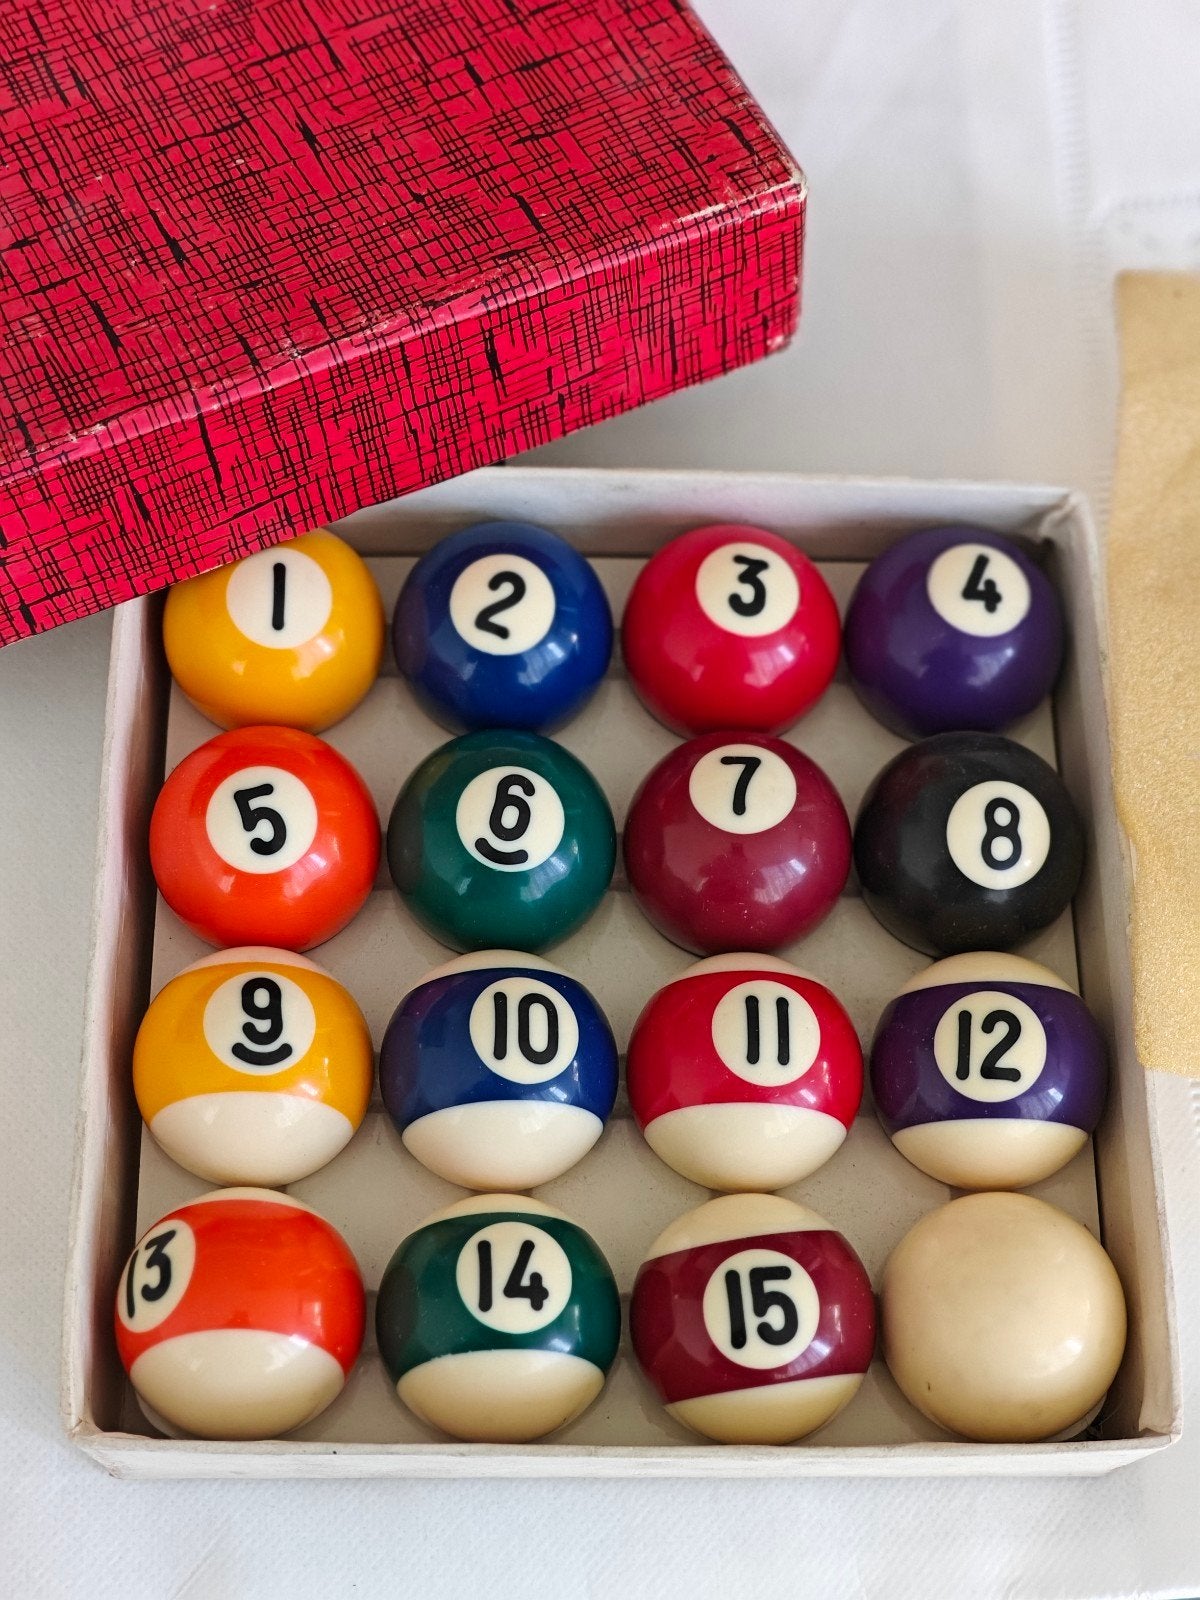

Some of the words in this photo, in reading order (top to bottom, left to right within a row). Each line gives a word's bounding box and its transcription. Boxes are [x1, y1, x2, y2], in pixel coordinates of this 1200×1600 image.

[272, 563, 287, 631] 1
[475, 571, 526, 640] 2
[729, 555, 769, 617] 3
[962, 555, 1002, 613] 4
[234, 784, 287, 856] 5
[475, 774, 536, 866] 6
[720, 756, 762, 816] 7
[981, 798, 1022, 871] 8
[232, 977, 293, 1067] 9
[493, 992, 559, 1065] 10
[745, 995, 790, 1066] 11
[956, 1010, 1022, 1083] 12
[126, 1229, 177, 1320] 13
[478, 1240, 549, 1313] 14
[725, 1266, 799, 1350] 15
